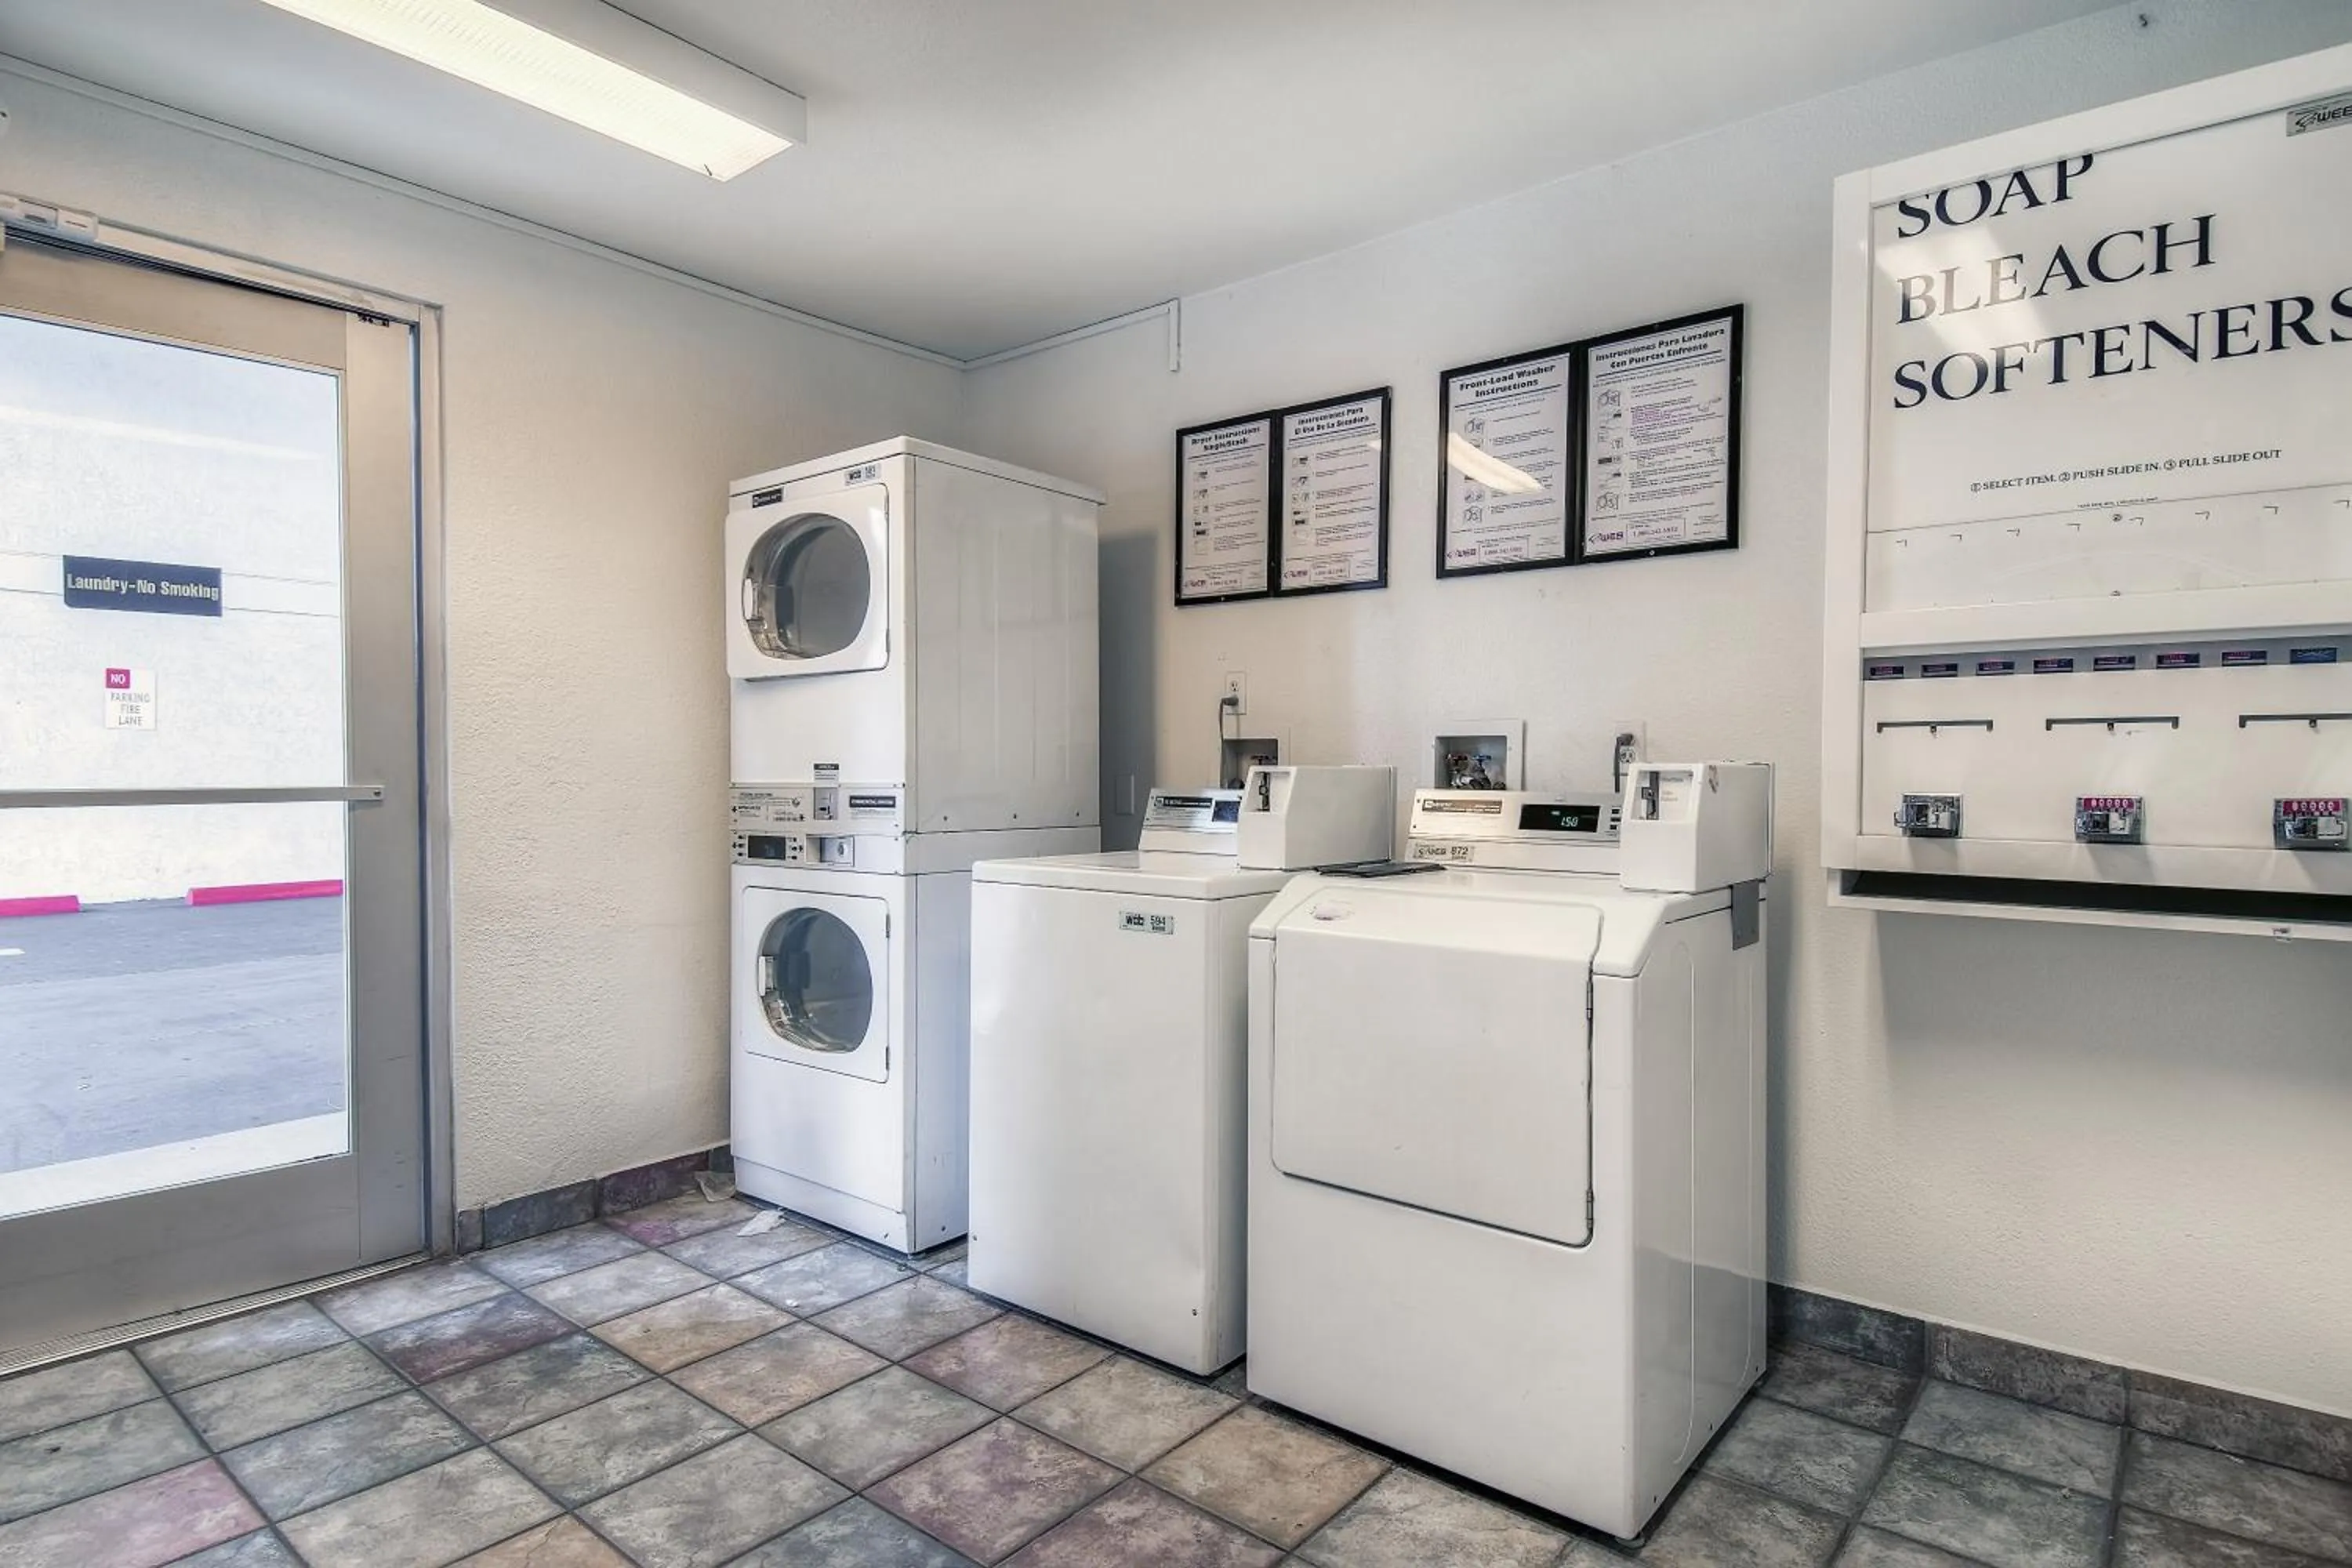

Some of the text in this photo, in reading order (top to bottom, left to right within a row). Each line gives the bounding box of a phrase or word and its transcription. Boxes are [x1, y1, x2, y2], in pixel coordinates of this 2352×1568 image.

[1898, 153, 2095, 238] SOAP
[1896, 213, 2216, 325] BLEACH
[1983, 477, 2024, 490] SELECT
[2072, 468, 2105, 481] PUSH
[2107, 463, 2143, 476] SLIDE
[2212, 452, 2251, 465] SLIDE
[2252, 449, 2282, 461] OUT
[161, 581, 220, 601] Smoking
[111, 673, 126, 684] NO
[111, 691, 151, 703] PARKING
[120, 703, 142, 714] FIRE
[118, 715, 143, 726] LANE
